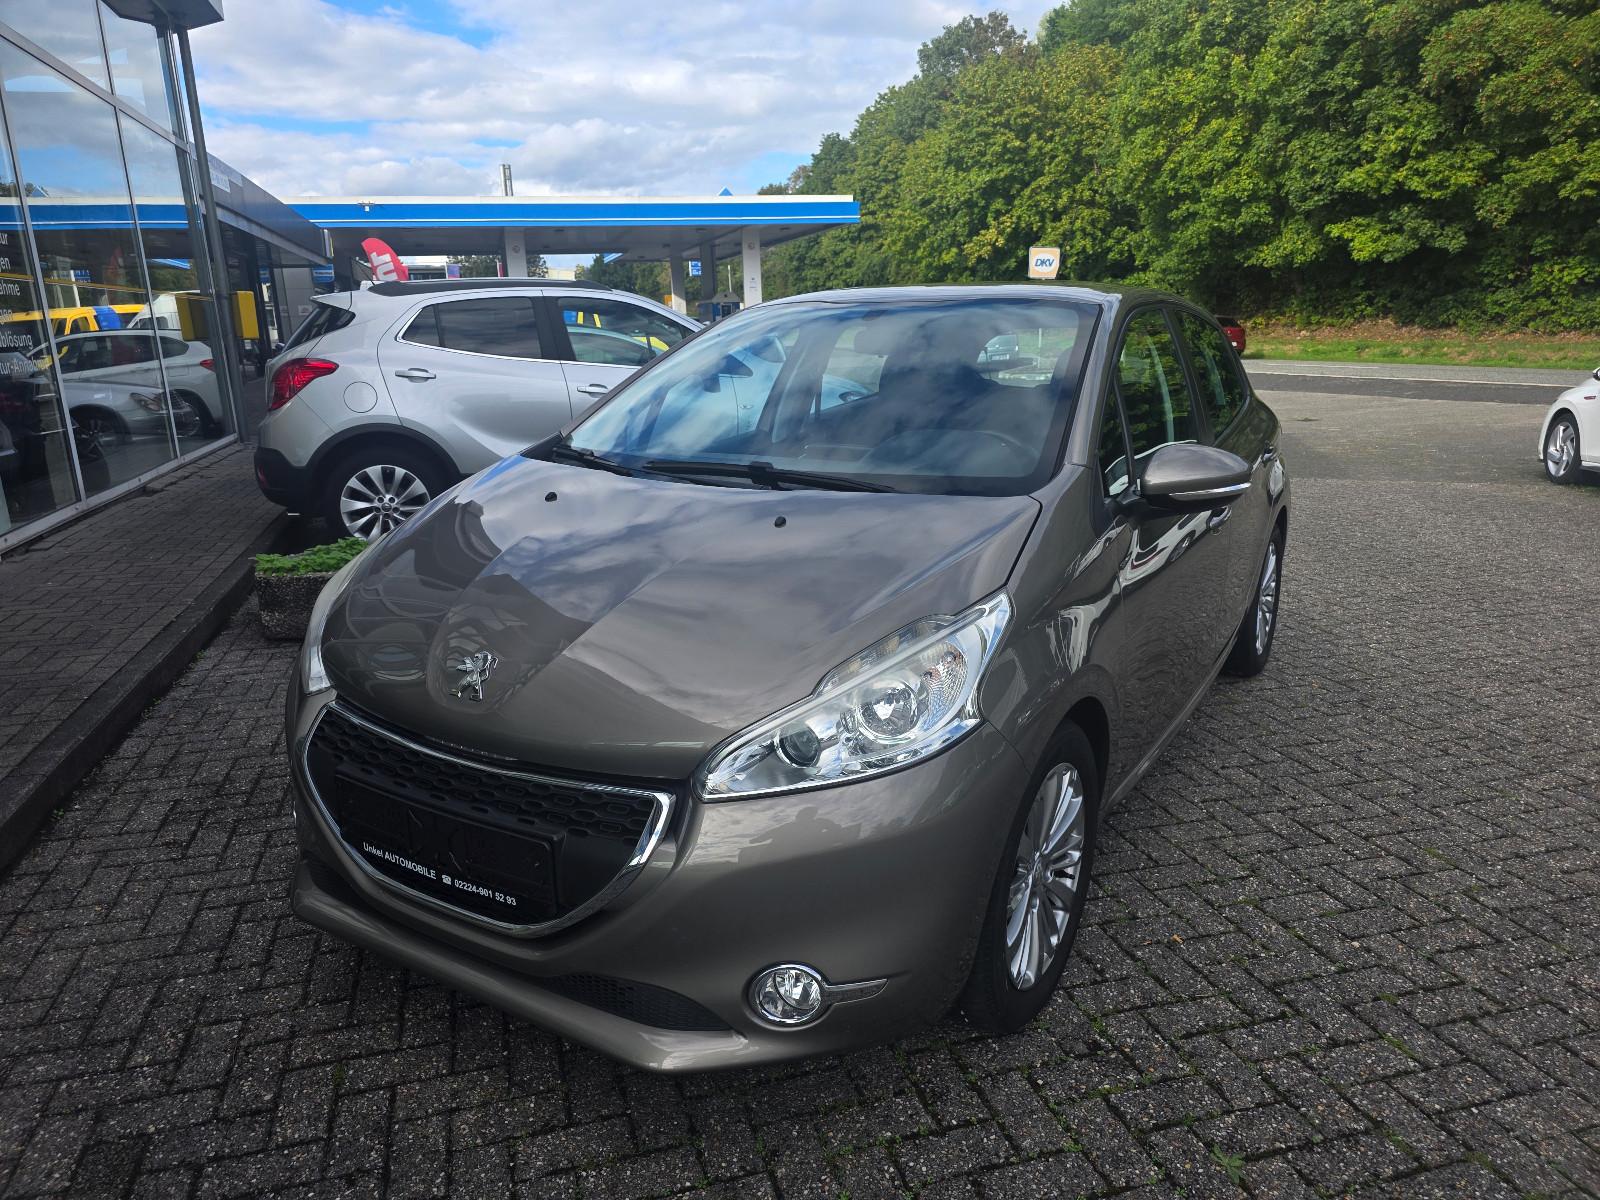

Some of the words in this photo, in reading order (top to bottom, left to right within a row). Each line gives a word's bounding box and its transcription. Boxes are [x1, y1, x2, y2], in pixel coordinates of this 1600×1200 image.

[1035, 258, 1055, 267] DKV
[363, 841, 383, 858] Unkel
[385, 851, 437, 880] AUTOMOBILE
[454, 879, 493, 899] 02224-901
[495, 892, 505, 903] 52
[506, 895, 517, 906] 93
